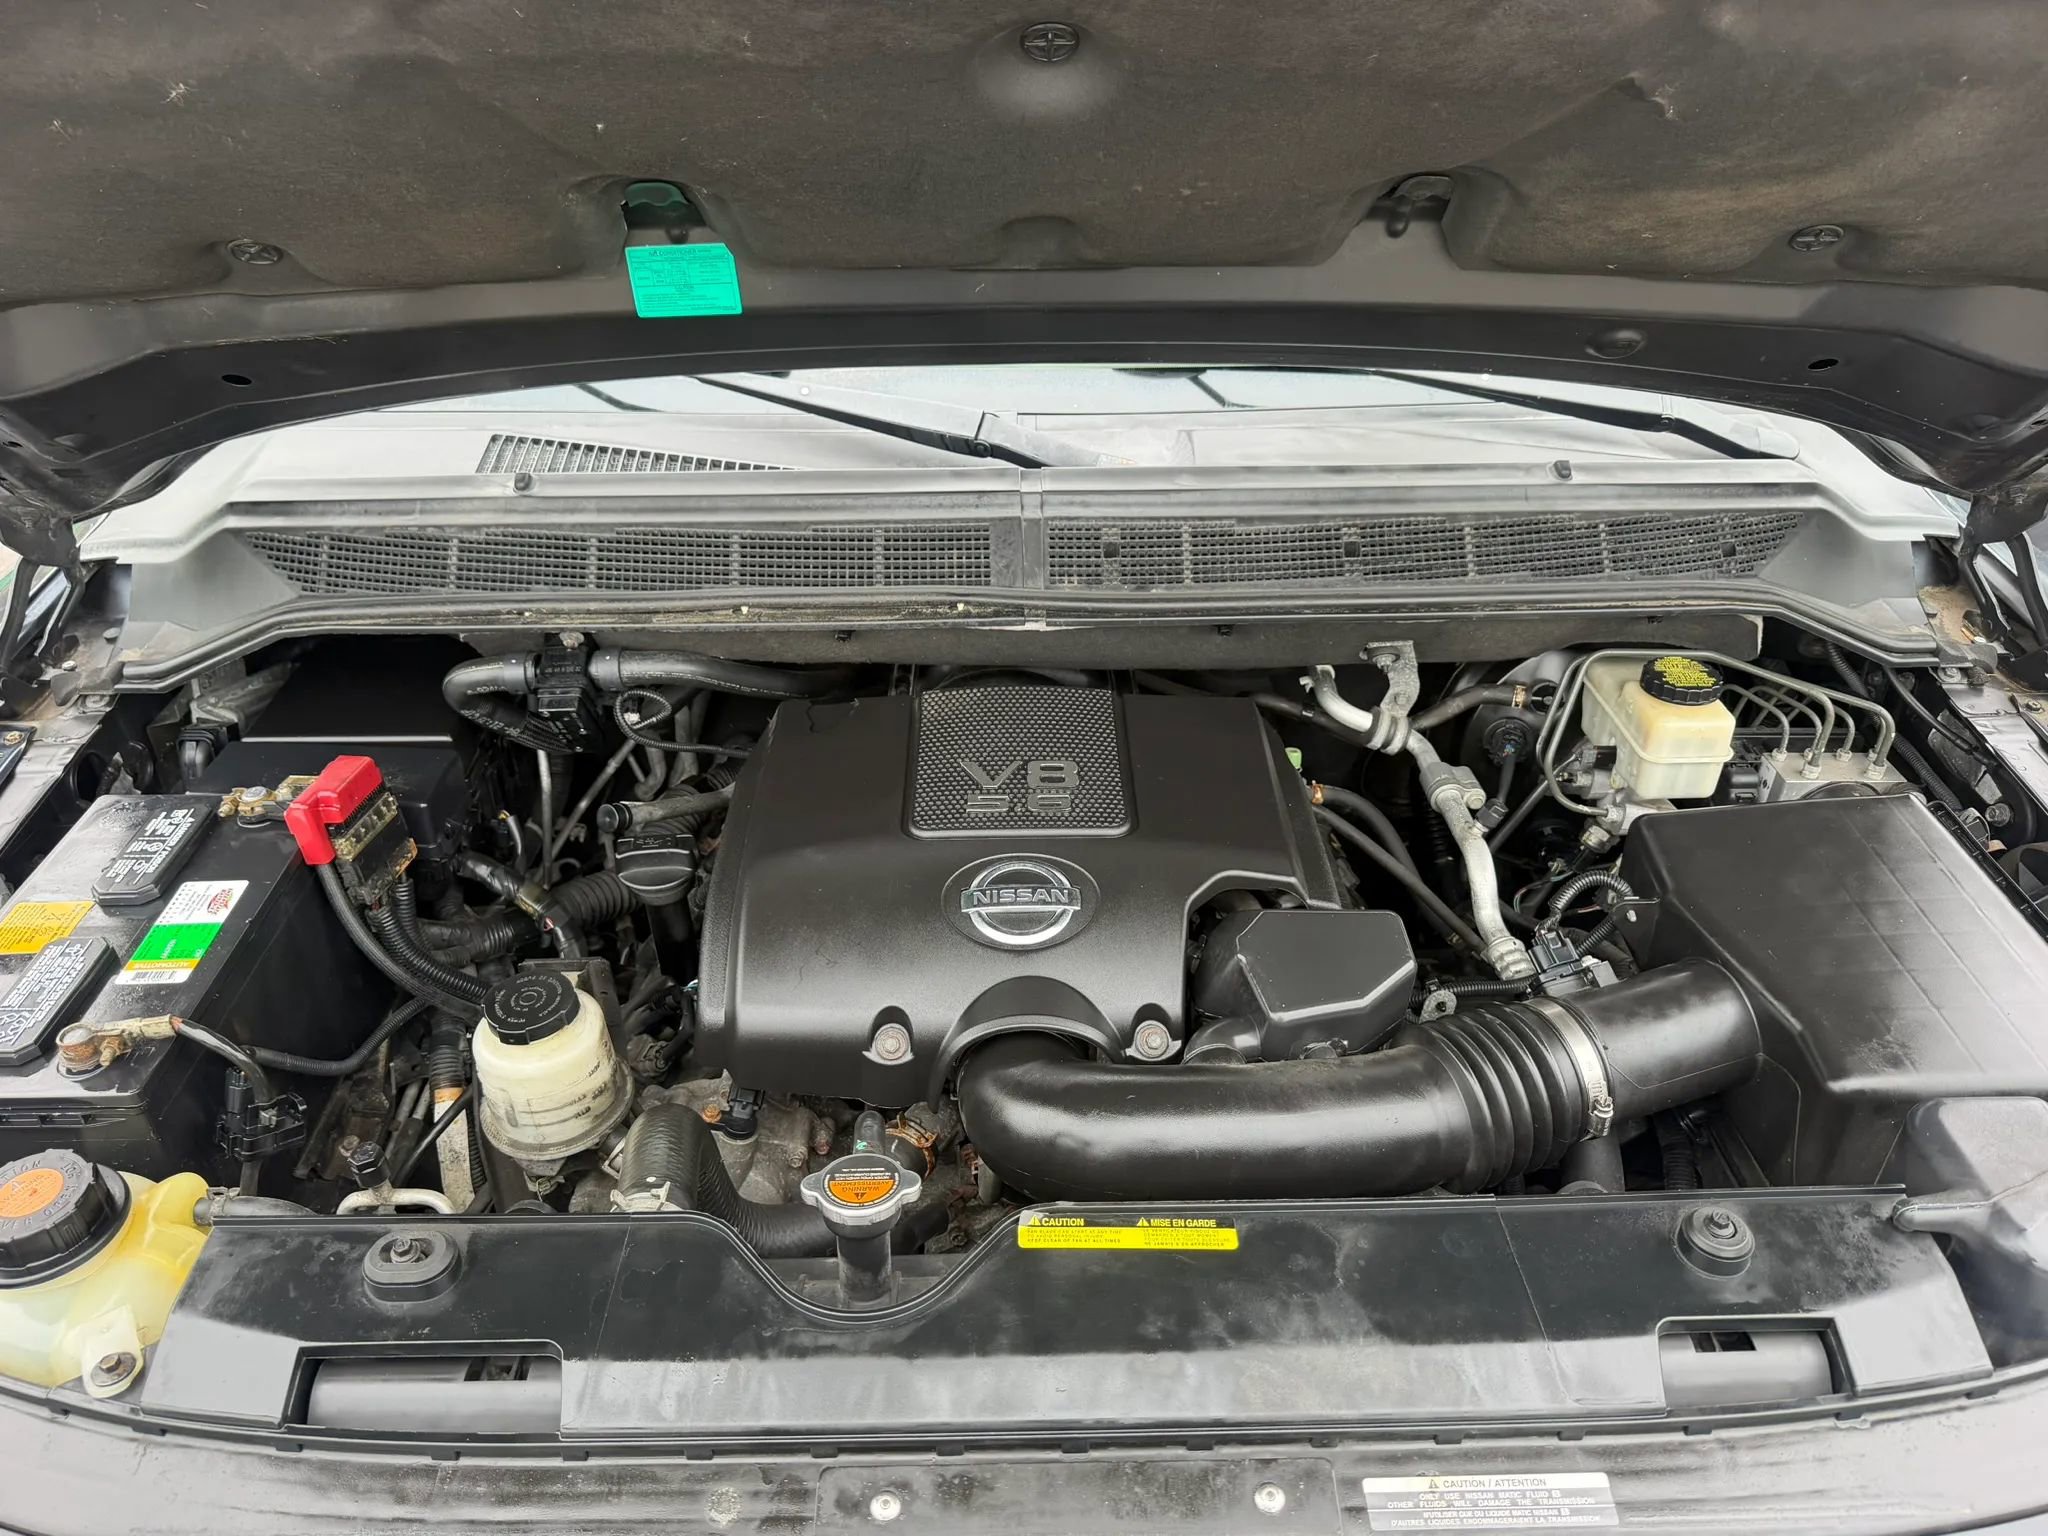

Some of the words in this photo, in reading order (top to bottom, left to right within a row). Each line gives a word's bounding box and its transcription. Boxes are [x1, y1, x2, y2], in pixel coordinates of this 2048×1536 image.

[959, 760, 1081, 789] V8
[973, 888, 1070, 905] NISSAN
[1041, 1217, 1085, 1226] CAUTION
[1150, 1218, 1171, 1227] MISE
[1172, 1218, 1185, 1227] EN
[1186, 1218, 1217, 1228] GARDE
[1443, 1479, 1485, 1488] CAUTION
[1495, 1478, 1547, 1488] ATTENTION
[1419, 1492, 1440, 1501] ONLY
[1444, 1492, 1461, 1500] USE
[1465, 1491, 1495, 1500] NISSAN
[1498, 1491, 1522, 1499] MATIC
[1526, 1490, 1549, 1498] FLUID
[1387, 1501, 1414, 1509] OTHER
[1419, 1500, 1447, 1508] FLUIDS
[1453, 1500, 1472, 1508] WILL
[1478, 1499, 1511, 1507] DAMAGE
[1517, 1498, 1533, 1506] THE
[1390, 1519, 1425, 1527] D'AUTRES
